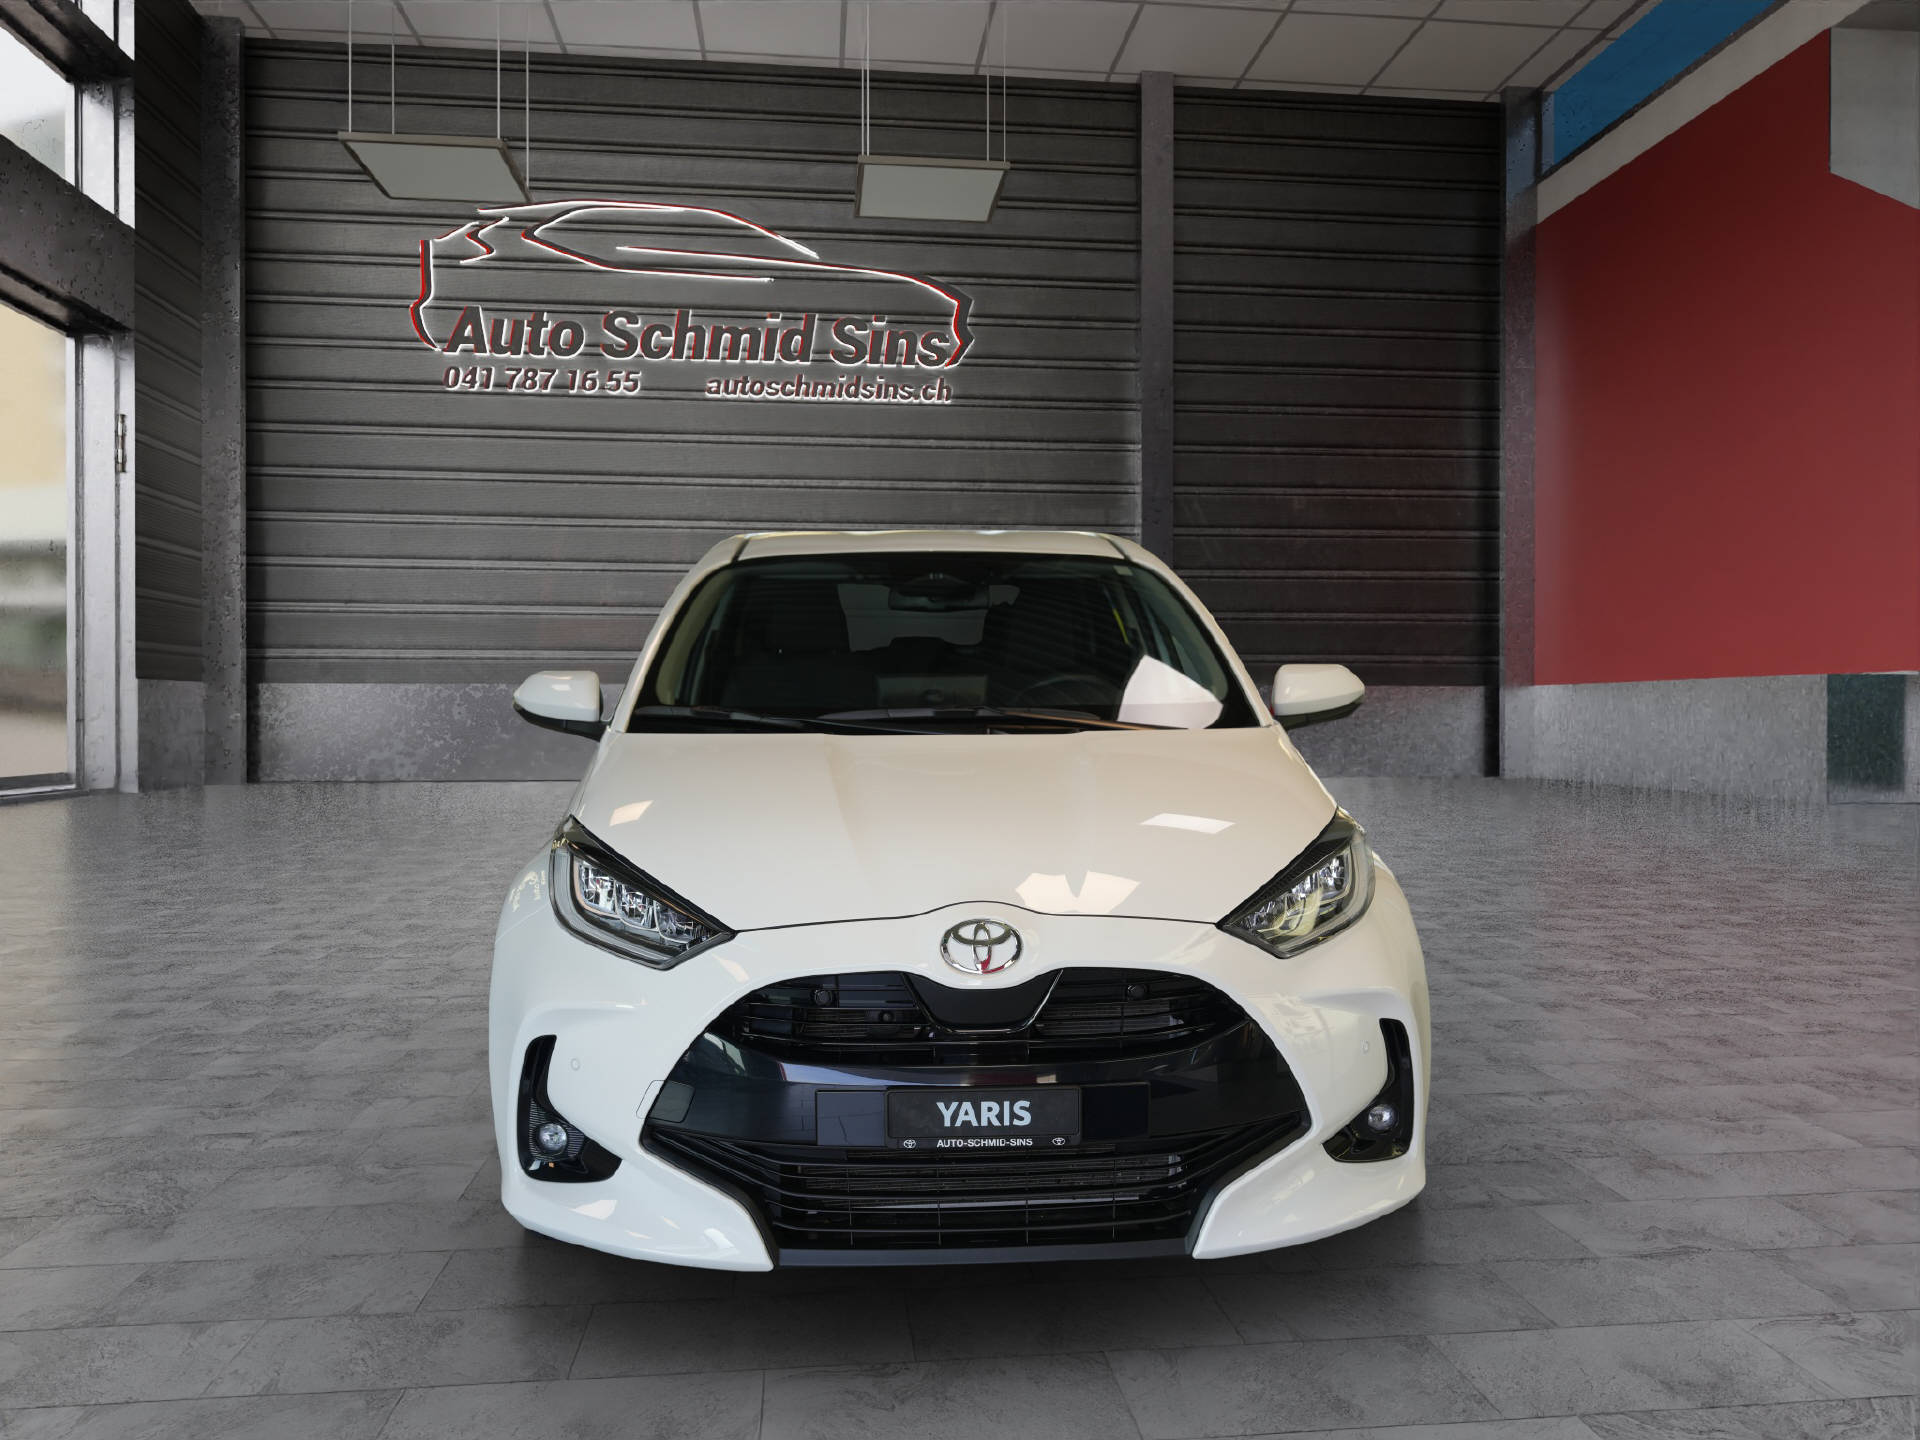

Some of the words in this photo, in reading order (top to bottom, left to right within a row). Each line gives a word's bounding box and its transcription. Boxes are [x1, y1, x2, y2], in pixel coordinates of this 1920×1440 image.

[443, 305, 586, 359] Auto
[600, 310, 819, 364] Schmid
[830, 314, 951, 369] Sins
[443, 366, 495, 391] 041
[504, 367, 559, 393] 787
[567, 369, 600, 394] 16
[604, 370, 642, 395] 55
[705, 374, 953, 403] autoschmidsins.ch
[936, 1100, 1032, 1127] YARIS
[936, 1138, 1033, 1148] AUTO-SCHMID-SINS
